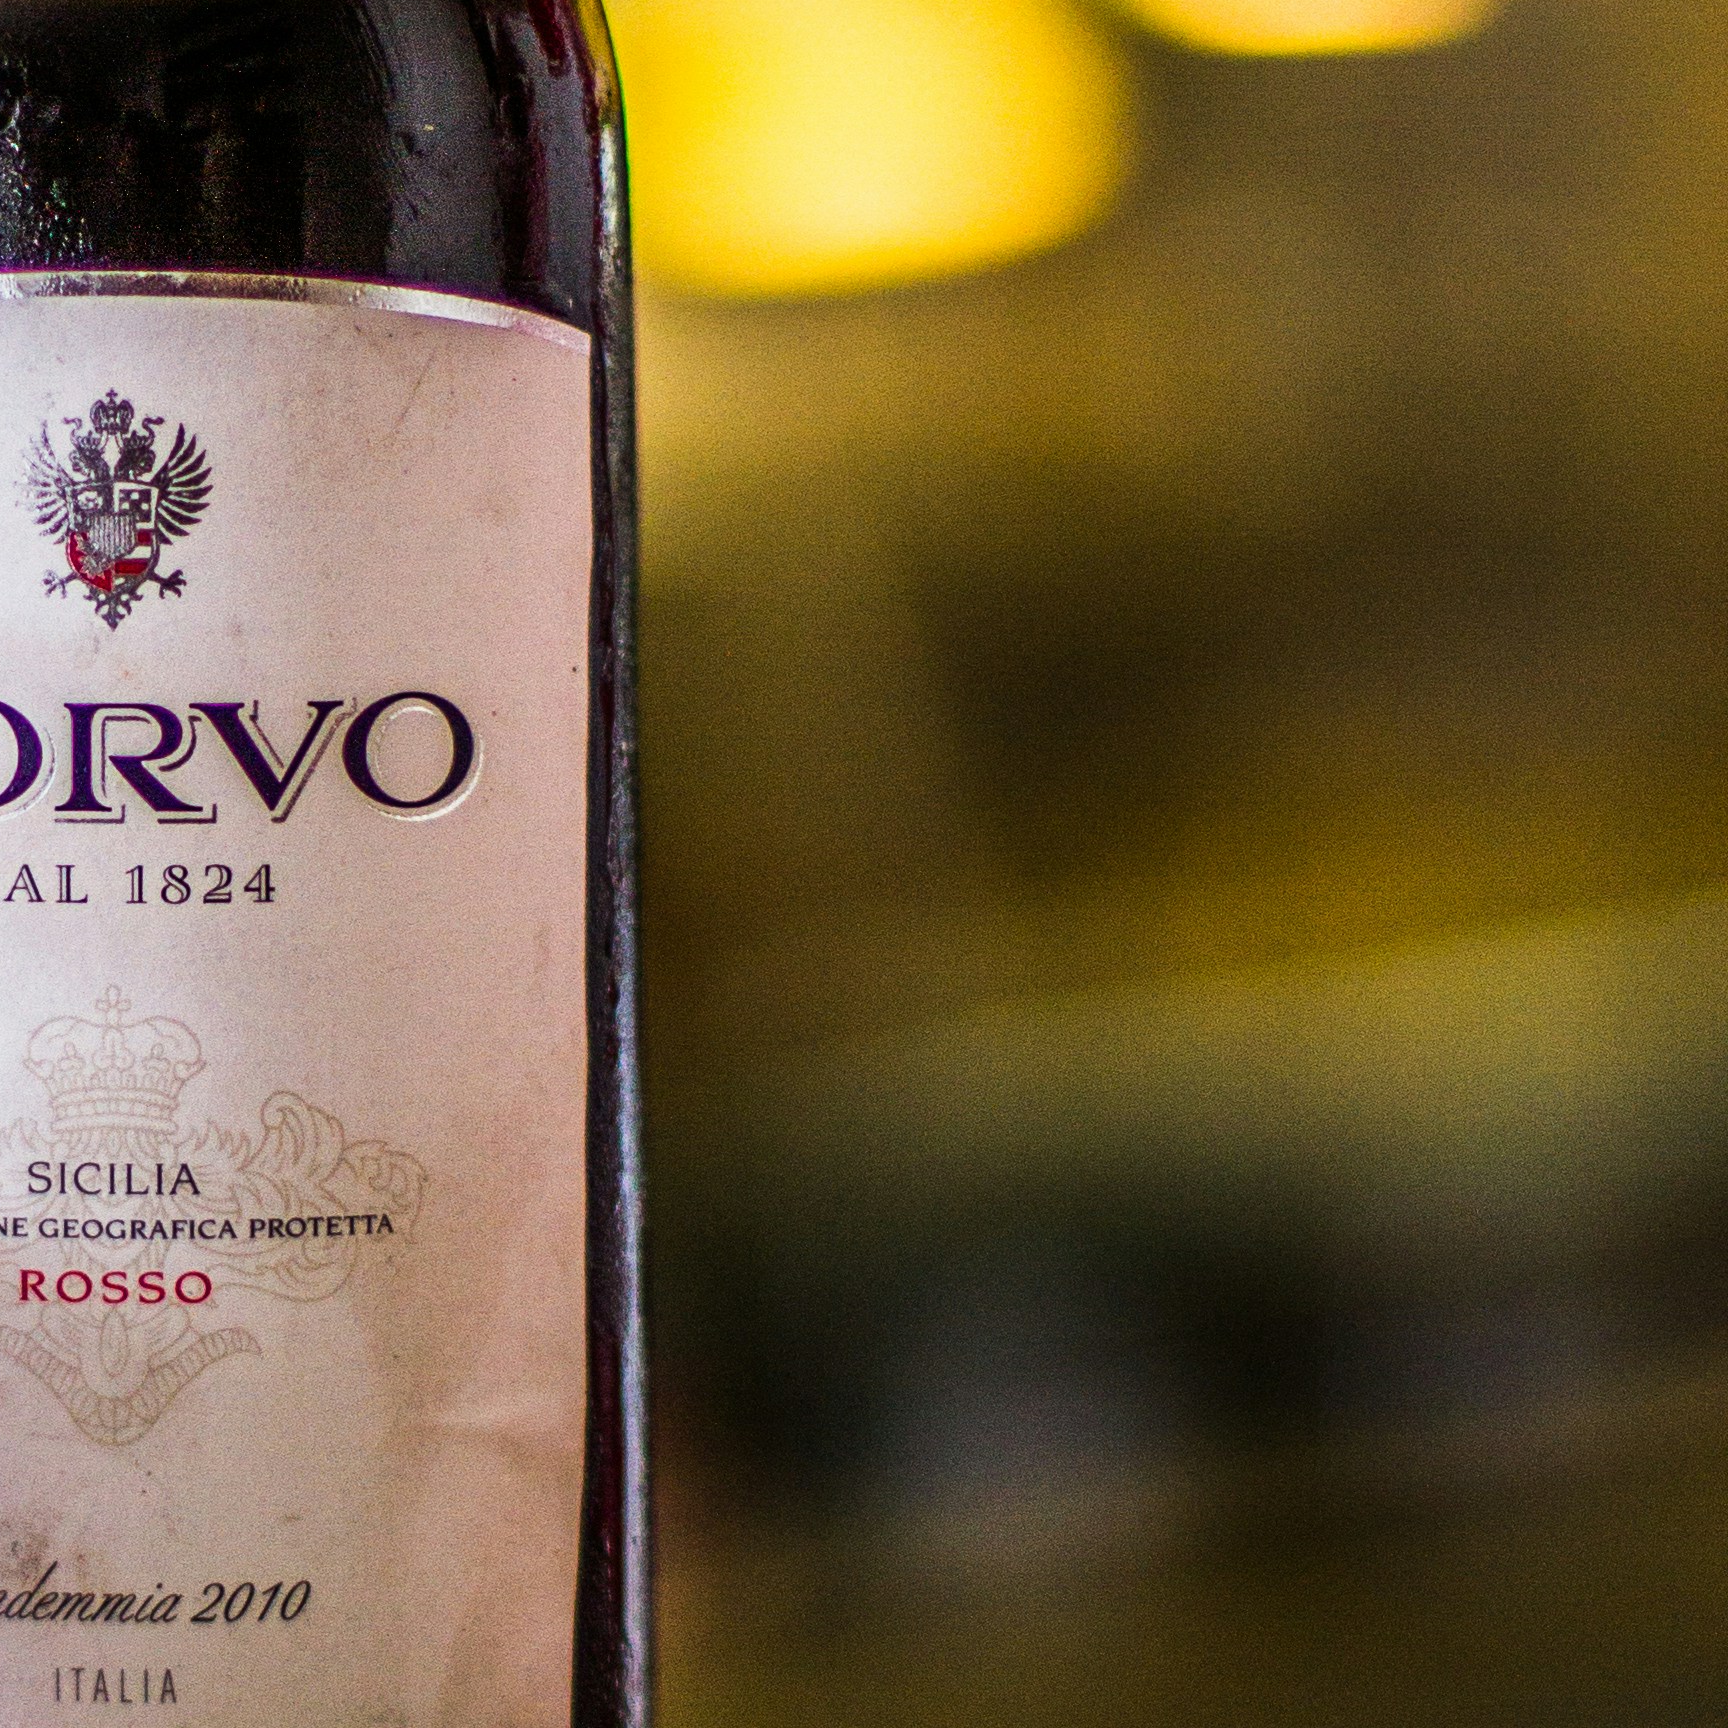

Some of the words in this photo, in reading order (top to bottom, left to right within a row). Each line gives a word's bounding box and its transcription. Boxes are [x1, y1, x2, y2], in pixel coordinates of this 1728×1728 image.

[125, 863, 276, 905] 1824
[27, 1160, 201, 1196] SICILIA
[38, 1217, 238, 1241] GEOGRAFICA
[248, 1213, 394, 1240] PROTETTA
[18, 1268, 213, 1304] ROSSO
[189, 1579, 312, 1624] 2010
[55, 1667, 177, 1703] ITALIA
